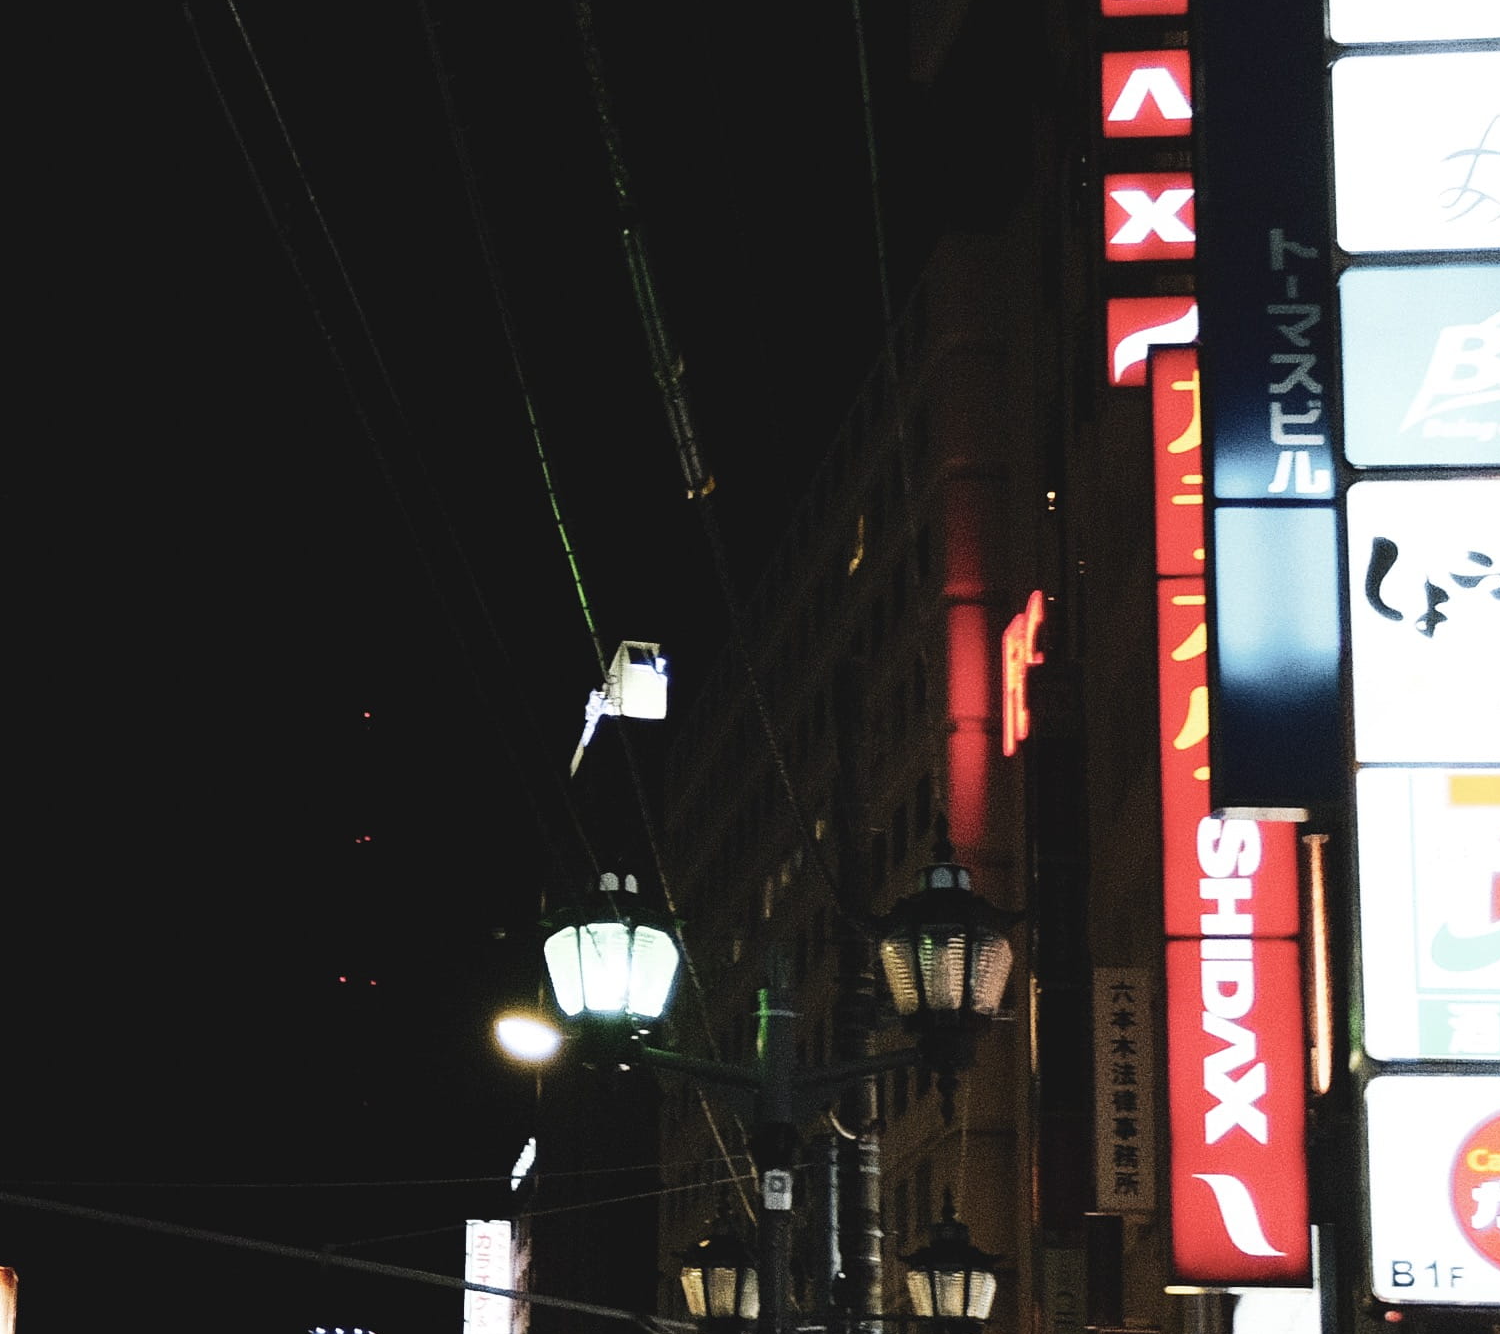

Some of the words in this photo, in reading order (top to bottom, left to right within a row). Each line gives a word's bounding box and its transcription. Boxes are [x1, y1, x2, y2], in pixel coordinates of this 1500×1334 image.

[1266, 228, 1331, 495] トーマスビル
